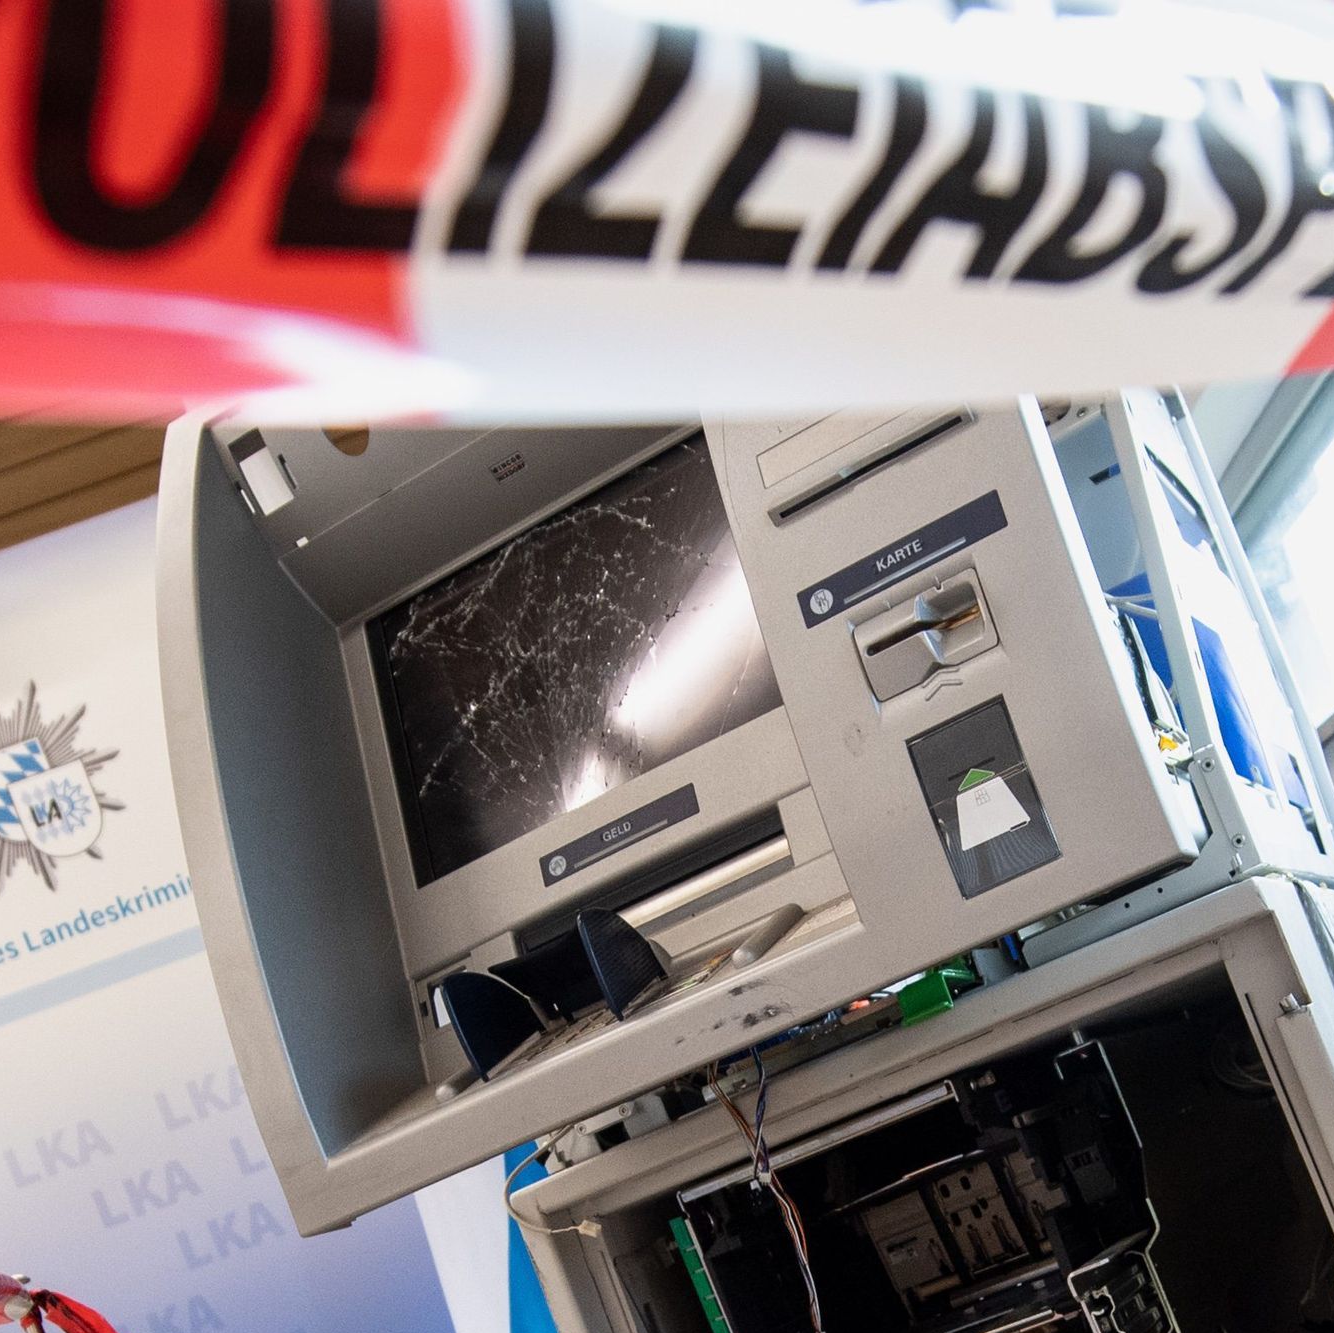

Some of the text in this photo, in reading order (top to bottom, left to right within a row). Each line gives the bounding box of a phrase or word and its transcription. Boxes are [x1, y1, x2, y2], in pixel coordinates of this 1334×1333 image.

[875, 539, 923, 572] KARTE
[602, 821, 632, 842] GELD
[3, 1118, 115, 1189] LKA
[91, 1158, 203, 1229] LKA
[175, 1201, 286, 1271] LKA
